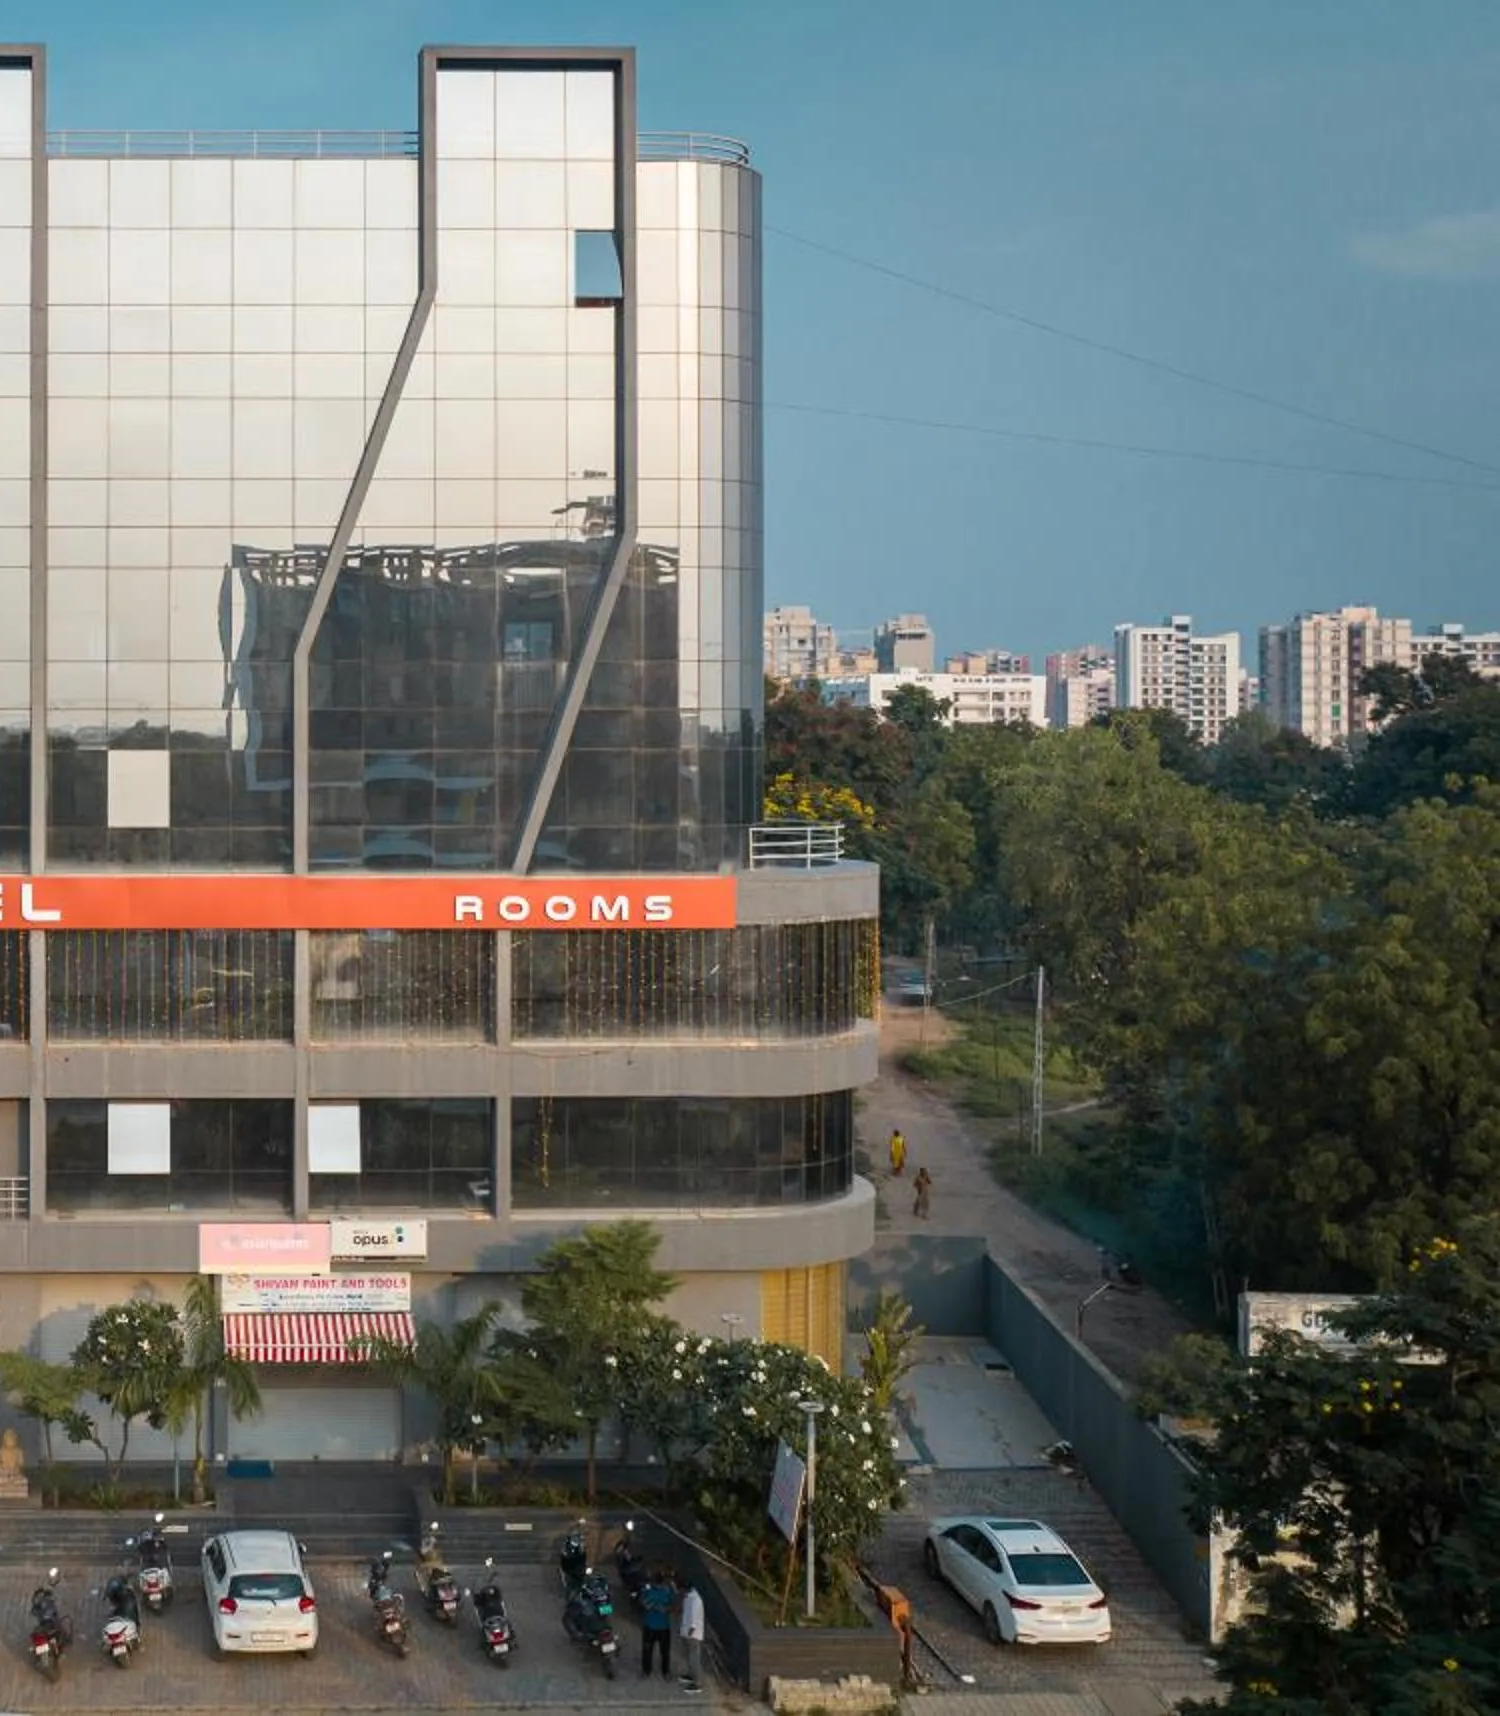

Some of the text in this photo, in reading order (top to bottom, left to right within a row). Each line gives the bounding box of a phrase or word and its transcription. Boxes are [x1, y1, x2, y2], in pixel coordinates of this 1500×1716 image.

[454, 895, 673, 921] ROOMS
[352, 1235, 388, 1247] opus
[303, 1278, 337, 1289] PAINT
[341, 1278, 366, 1289] AND
[369, 1277, 407, 1289] TOOLS
